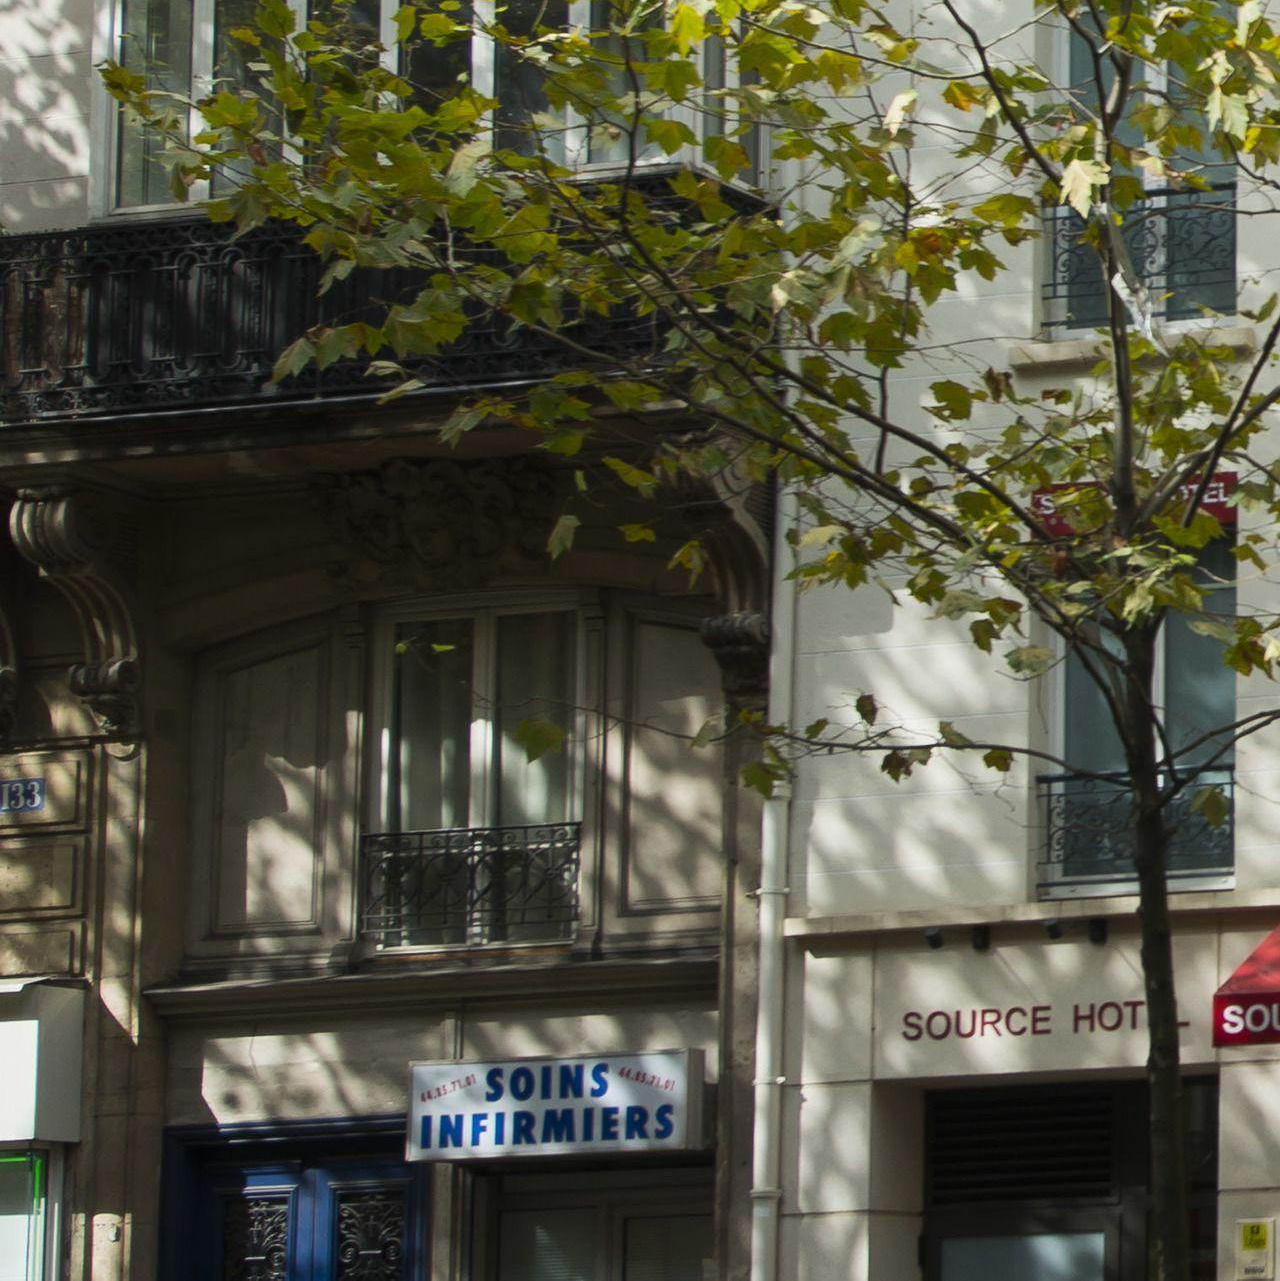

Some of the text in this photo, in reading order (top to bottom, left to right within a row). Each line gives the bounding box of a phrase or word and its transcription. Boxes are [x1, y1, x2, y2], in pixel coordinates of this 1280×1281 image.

[0, 781, 41, 810] 133
[901, 1000, 1191, 1041] SOURCE HOT
[485, 1062, 609, 1103] SOINS
[420, 1103, 674, 1150] INFIRMIERS
